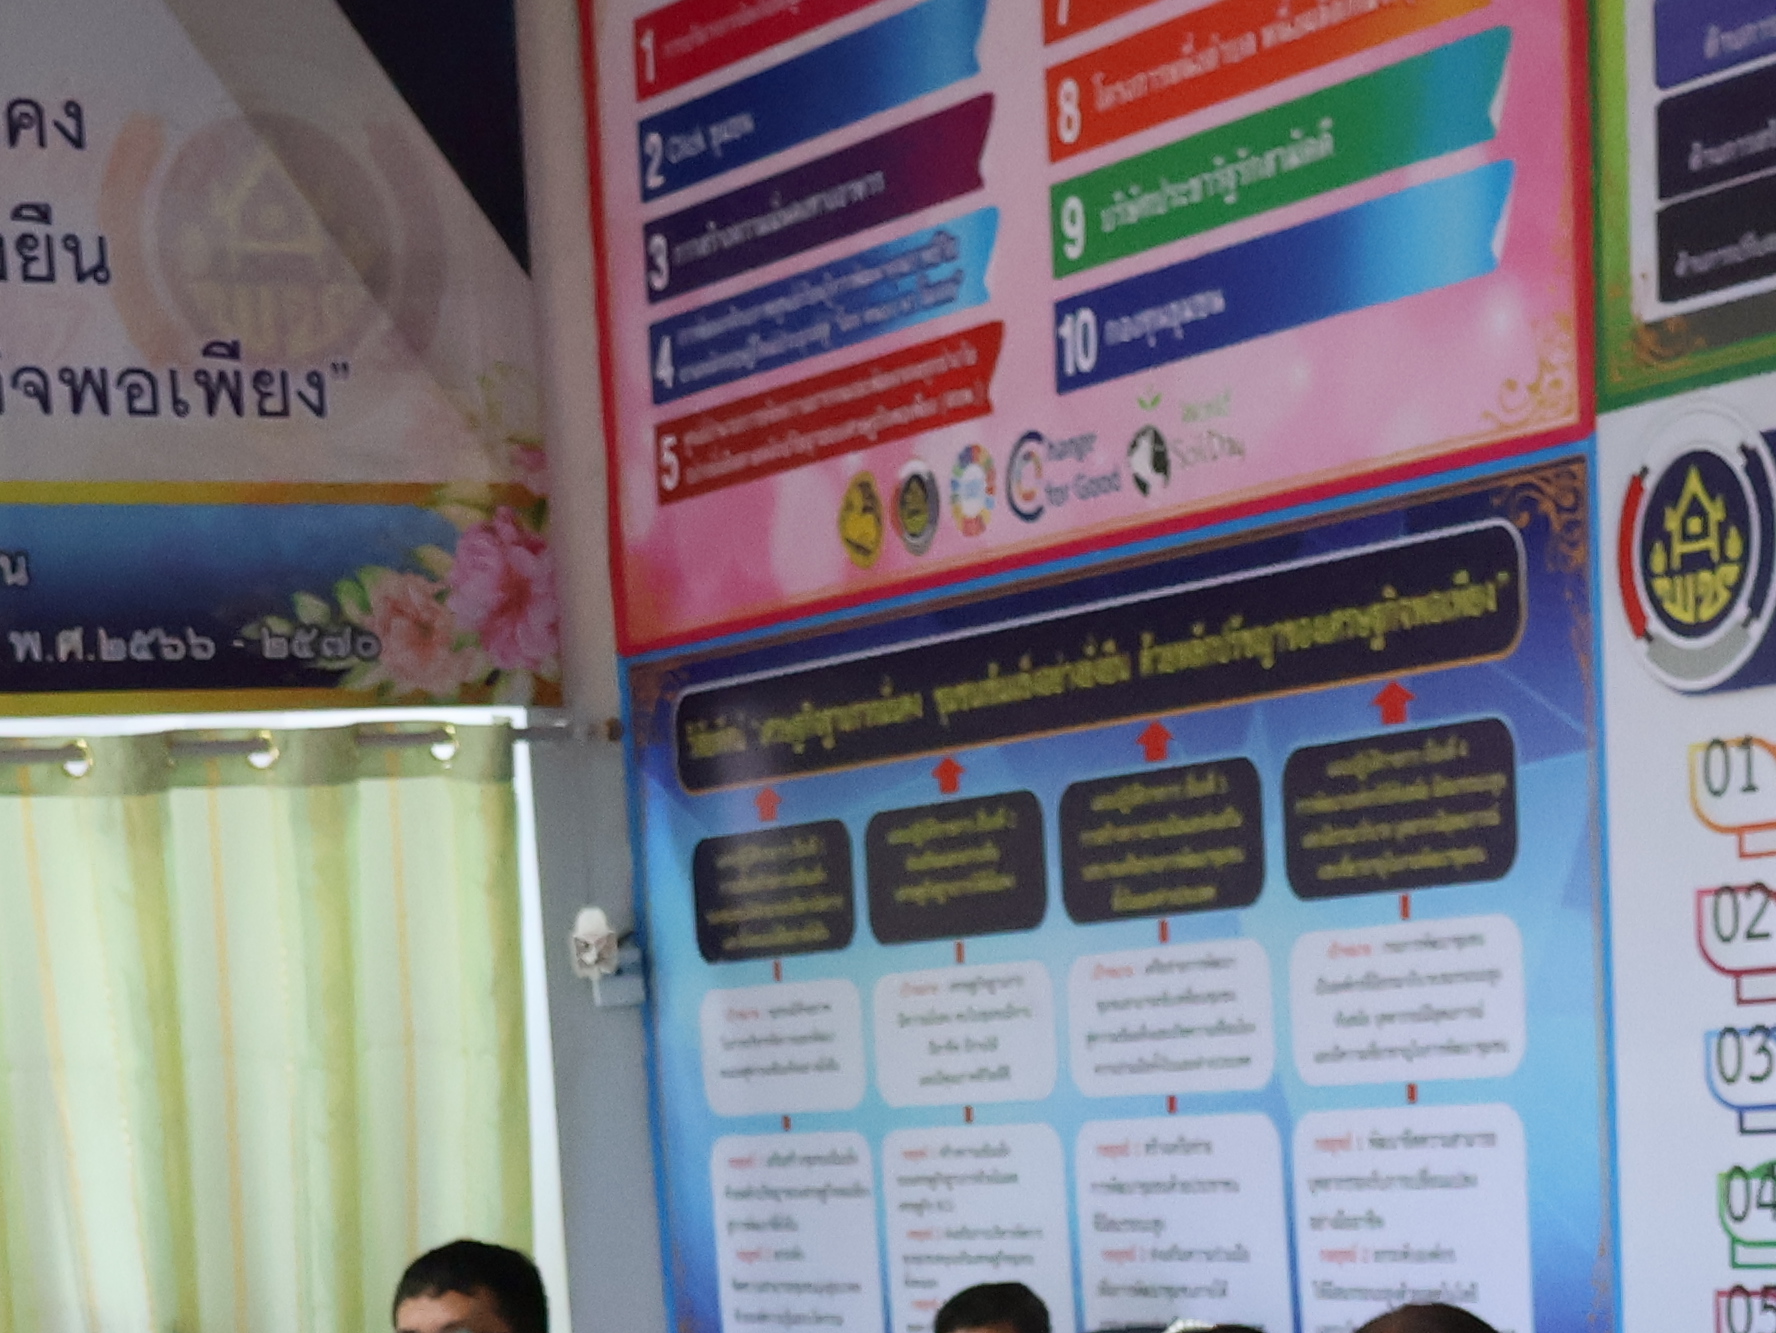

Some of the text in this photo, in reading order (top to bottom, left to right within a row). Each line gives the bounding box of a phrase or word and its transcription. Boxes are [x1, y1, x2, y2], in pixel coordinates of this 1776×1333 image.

[640, 28, 656, 83] 1
[1056, 77, 1082, 144] 8
[645, 132, 665, 189] 2
[1059, 195, 1086, 260] 9
[648, 233, 669, 291] 3
[654, 335, 674, 389] 4
[1057, 307, 1098, 377] 10
[660, 434, 680, 491] 5
[1703, 735, 1758, 796] 01
[1711, 882, 1772, 943] 02
[1716, 1025, 1776, 1085] 03
